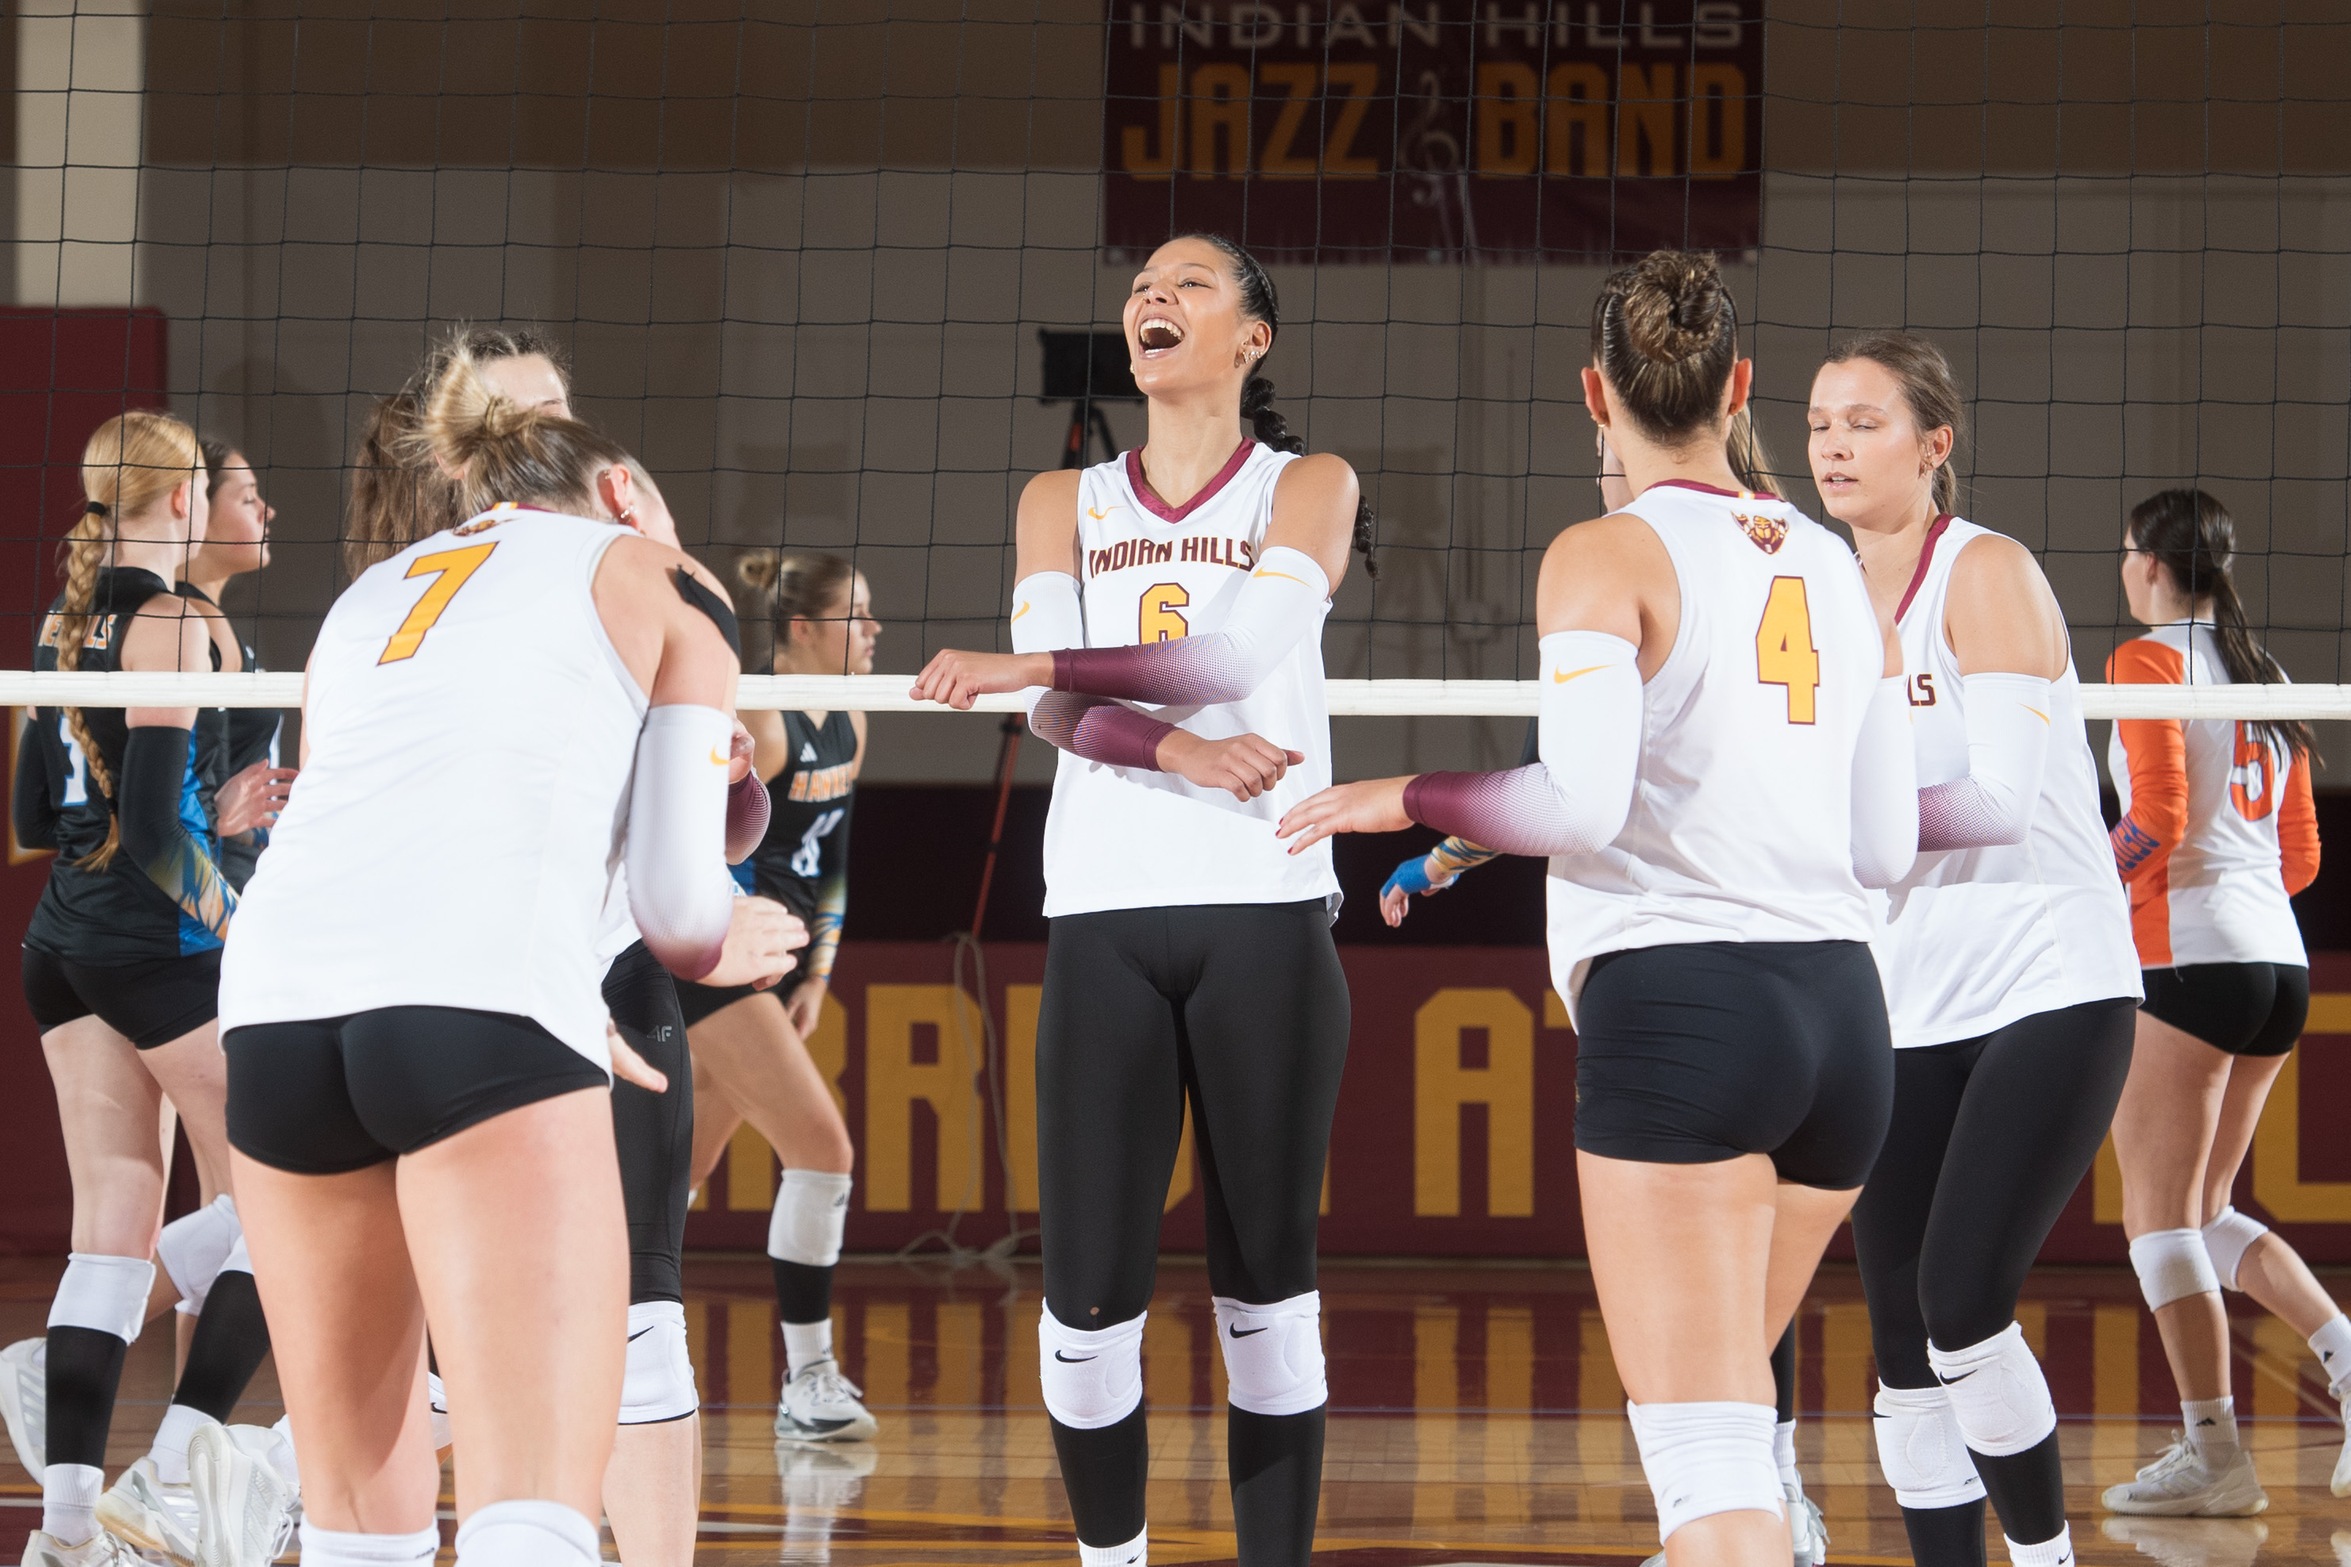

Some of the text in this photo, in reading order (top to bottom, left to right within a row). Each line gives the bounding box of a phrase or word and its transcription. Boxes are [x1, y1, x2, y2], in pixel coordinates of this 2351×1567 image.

[1131, 3, 1744, 48] INDIAN HILLS
[1121, 62, 1747, 180] JAZZ BAND
[1088, 536, 1256, 579] INDIAN HILLS
[376, 540, 501, 667] 7
[1138, 582, 1190, 645] 6
[1755, 575, 1820, 726] 4
